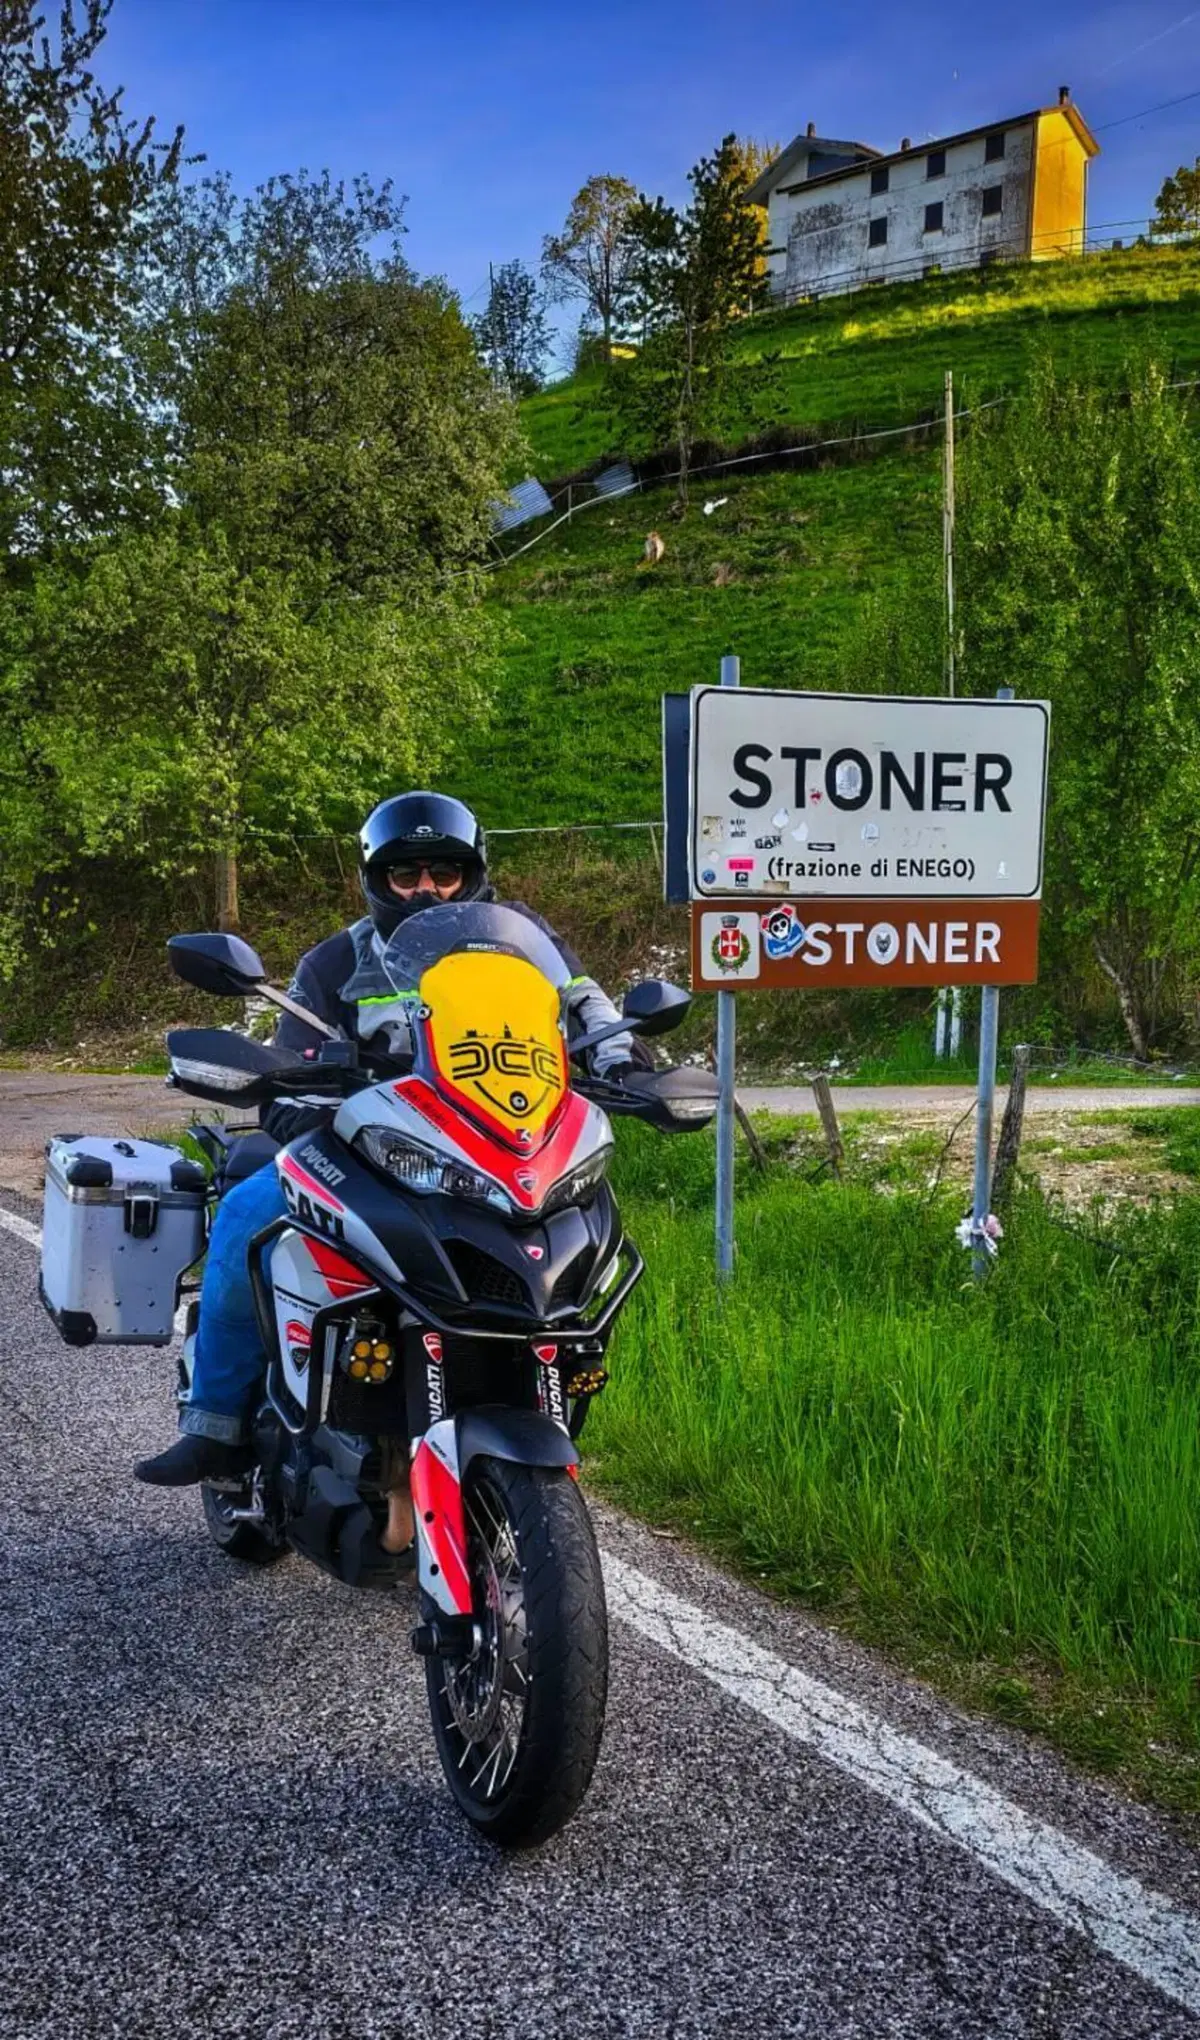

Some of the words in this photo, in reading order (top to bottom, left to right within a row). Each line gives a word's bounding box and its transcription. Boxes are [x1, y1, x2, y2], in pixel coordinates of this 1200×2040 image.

[730, 743, 1013, 812] STONER
[767, 856, 862, 881] (frazione
[870, 858, 888, 877] di
[896, 859, 976, 881] ENEGO)
[801, 922, 1001, 966] STONER
[300, 1144, 346, 1187] DUCATI
